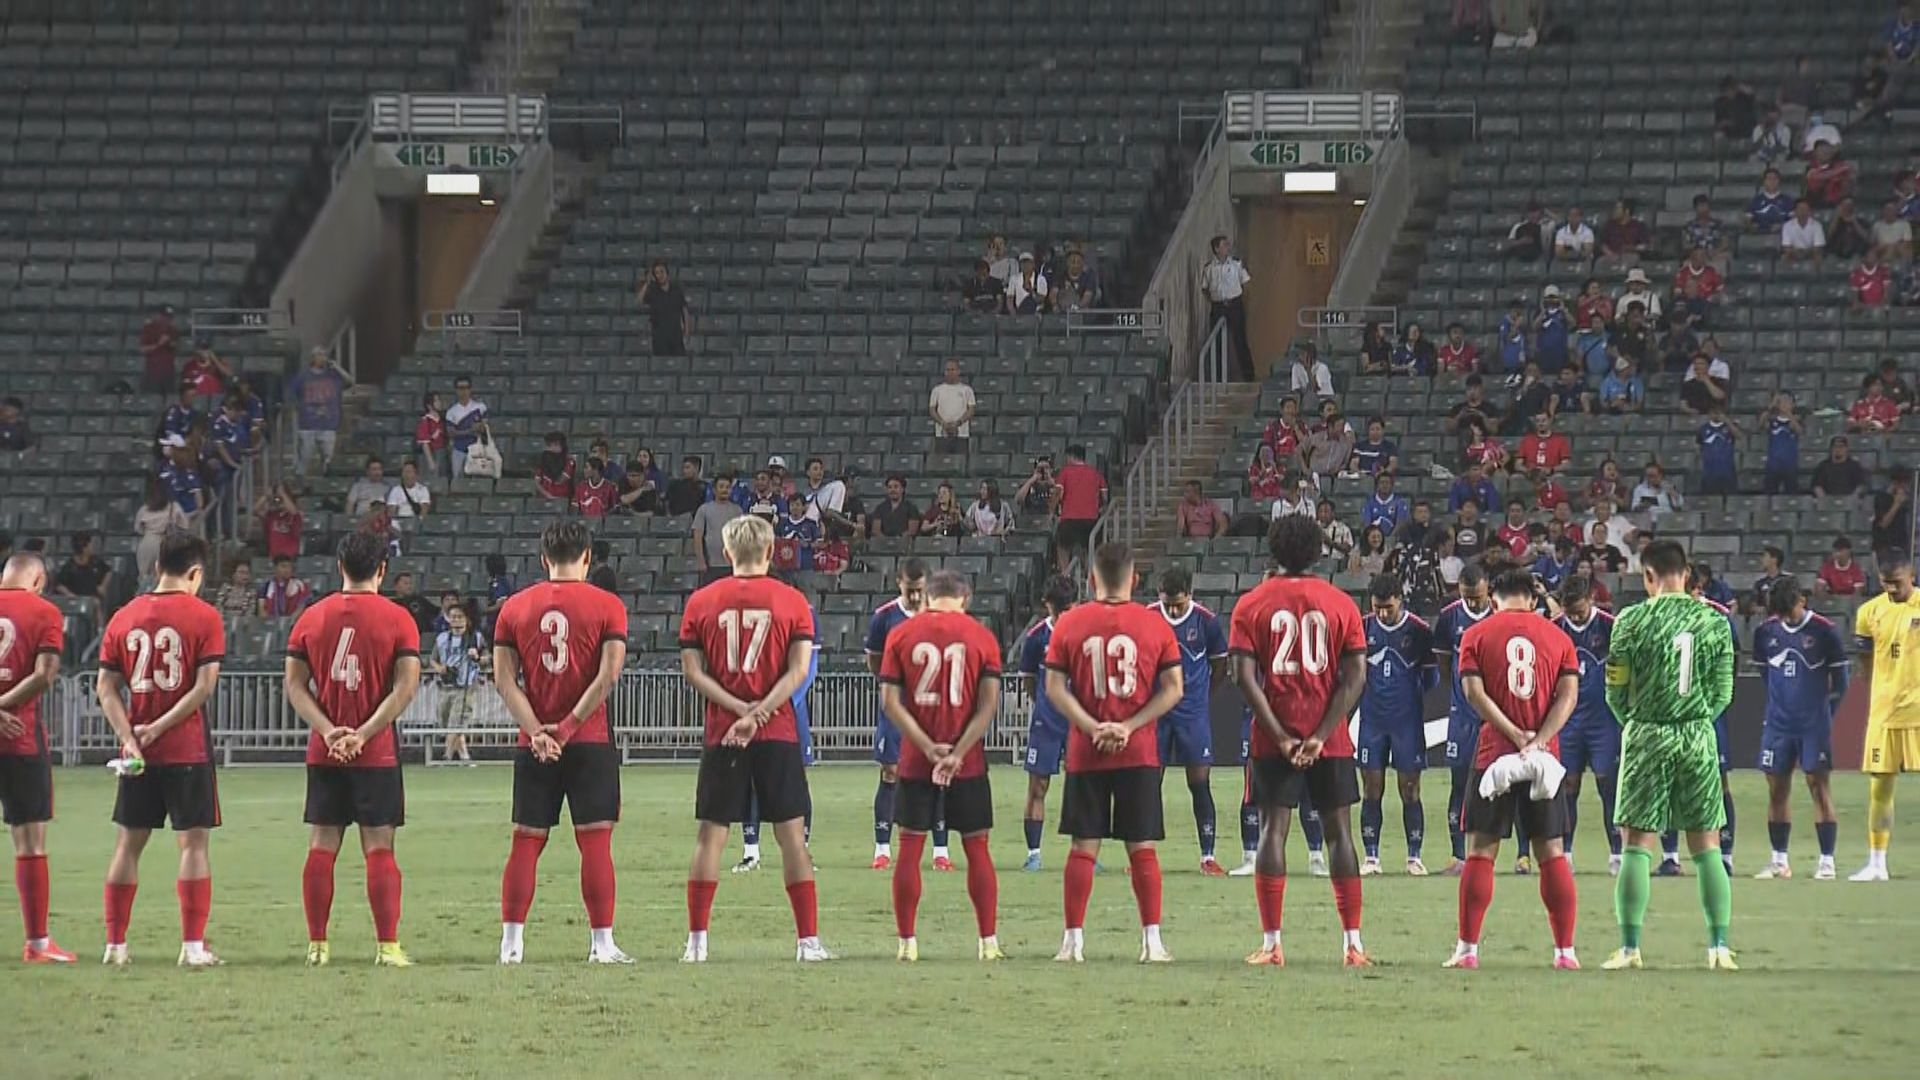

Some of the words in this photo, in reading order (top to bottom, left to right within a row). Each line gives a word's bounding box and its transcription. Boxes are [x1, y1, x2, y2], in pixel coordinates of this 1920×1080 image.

[403, 145, 441, 166] 114
[470, 145, 509, 166] 115
[1260, 143, 1296, 164] 115
[1328, 143, 1365, 164] 116
[243, 314, 261, 327] 114
[451, 315, 470, 326] 115
[1116, 314, 1136, 326] 115
[1325, 311, 1344, 324] 116
[540, 610, 569, 674] 3
[718, 609, 772, 673] 17
[1271, 610, 1328, 675] 20
[126, 626, 182, 693] 23
[331, 627, 361, 691] 4
[1083, 634, 1137, 699] 13
[1383, 660, 1391, 677] 8
[1506, 636, 1536, 700] 8
[1673, 631, 1694, 697] 1
[1784, 660, 1796, 677] 21
[912, 642, 966, 707] 21
[1361, 748, 1368, 763] 8
[1446, 740, 1458, 757] 23
[1762, 750, 1774, 767] 21
